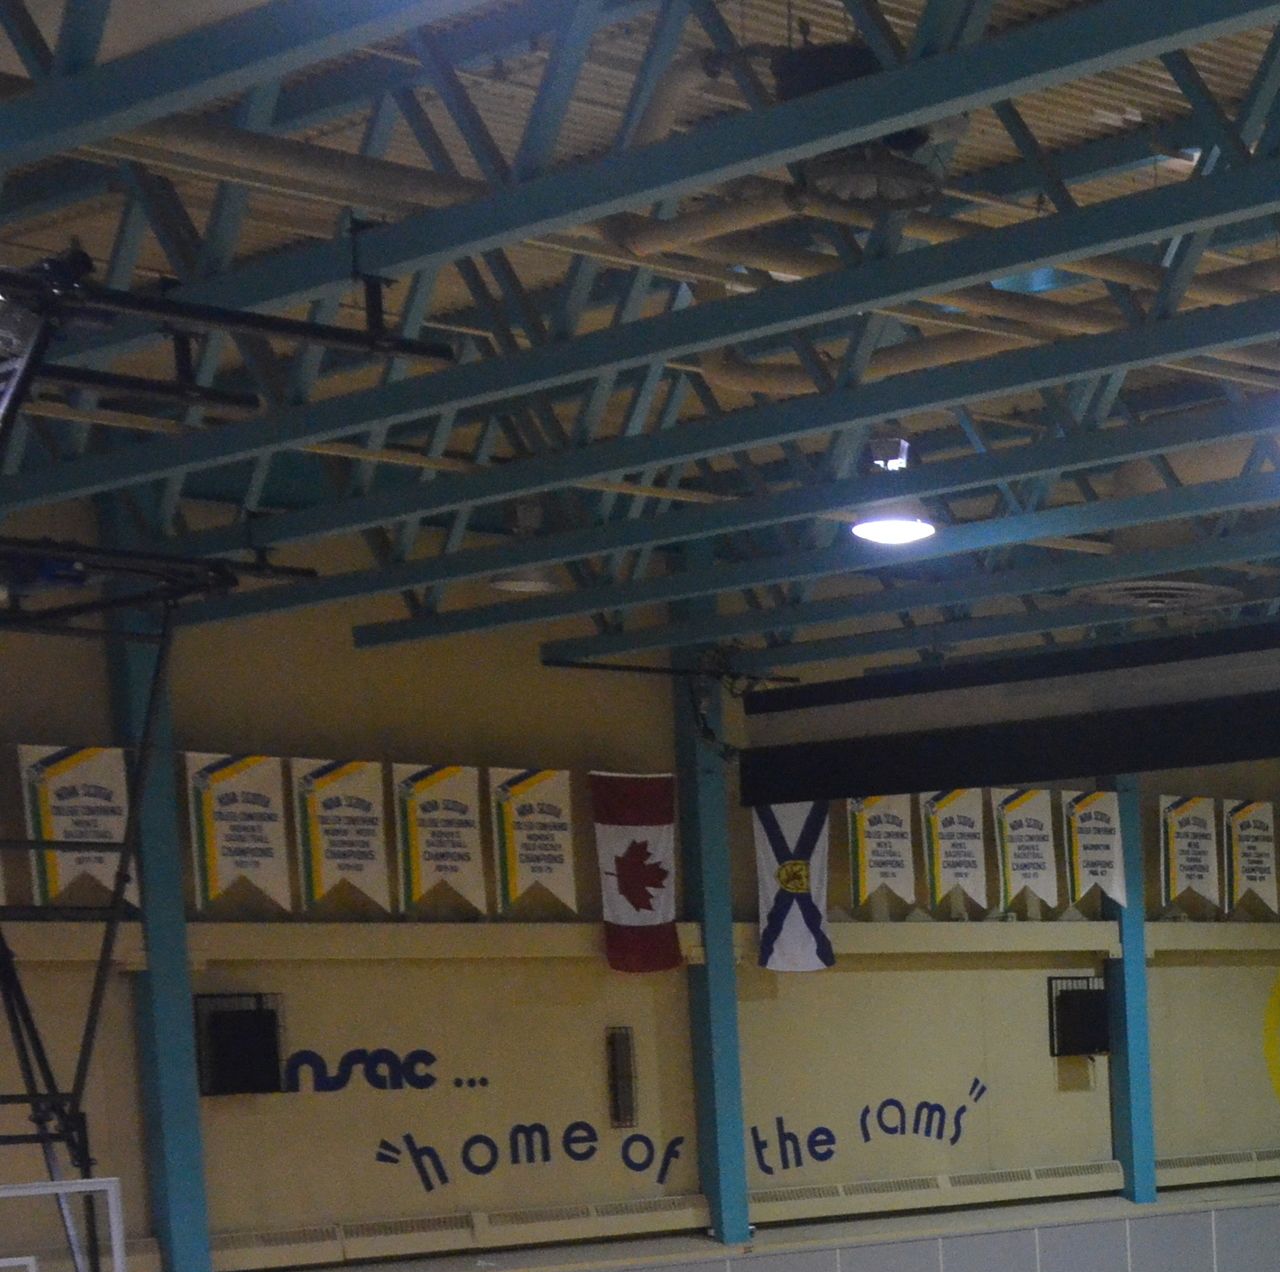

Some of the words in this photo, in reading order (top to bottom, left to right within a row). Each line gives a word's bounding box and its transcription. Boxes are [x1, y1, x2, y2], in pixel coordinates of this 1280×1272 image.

[286, 1049, 437, 1091] nsac
[621, 1133, 684, 1184] of
[751, 1116, 838, 1176] the
